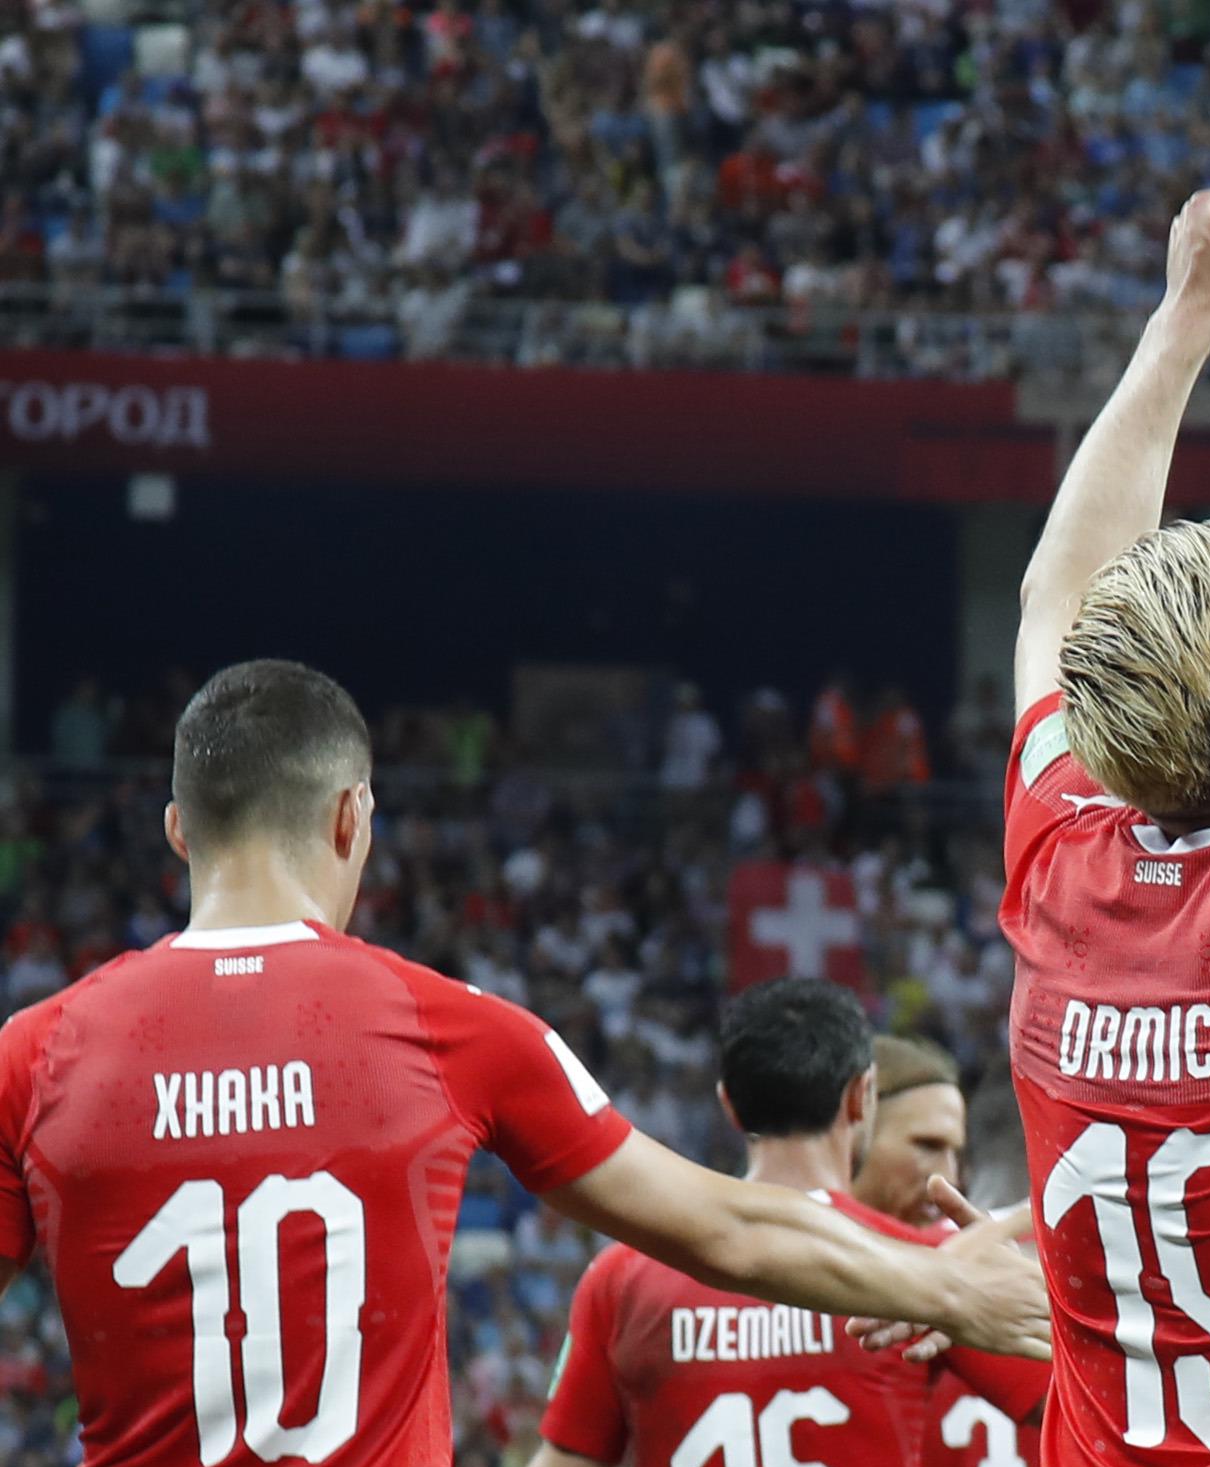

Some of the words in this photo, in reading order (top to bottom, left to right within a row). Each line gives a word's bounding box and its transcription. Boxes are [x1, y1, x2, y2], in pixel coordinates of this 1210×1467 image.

[0, 378, 210, 449] ОРОД
[1133, 860, 1184, 888] SUISSE
[214, 955, 264, 977] SUISSE
[153, 1060, 316, 1140] XHAKA
[671, 1303, 834, 1363] DZEMAILI
